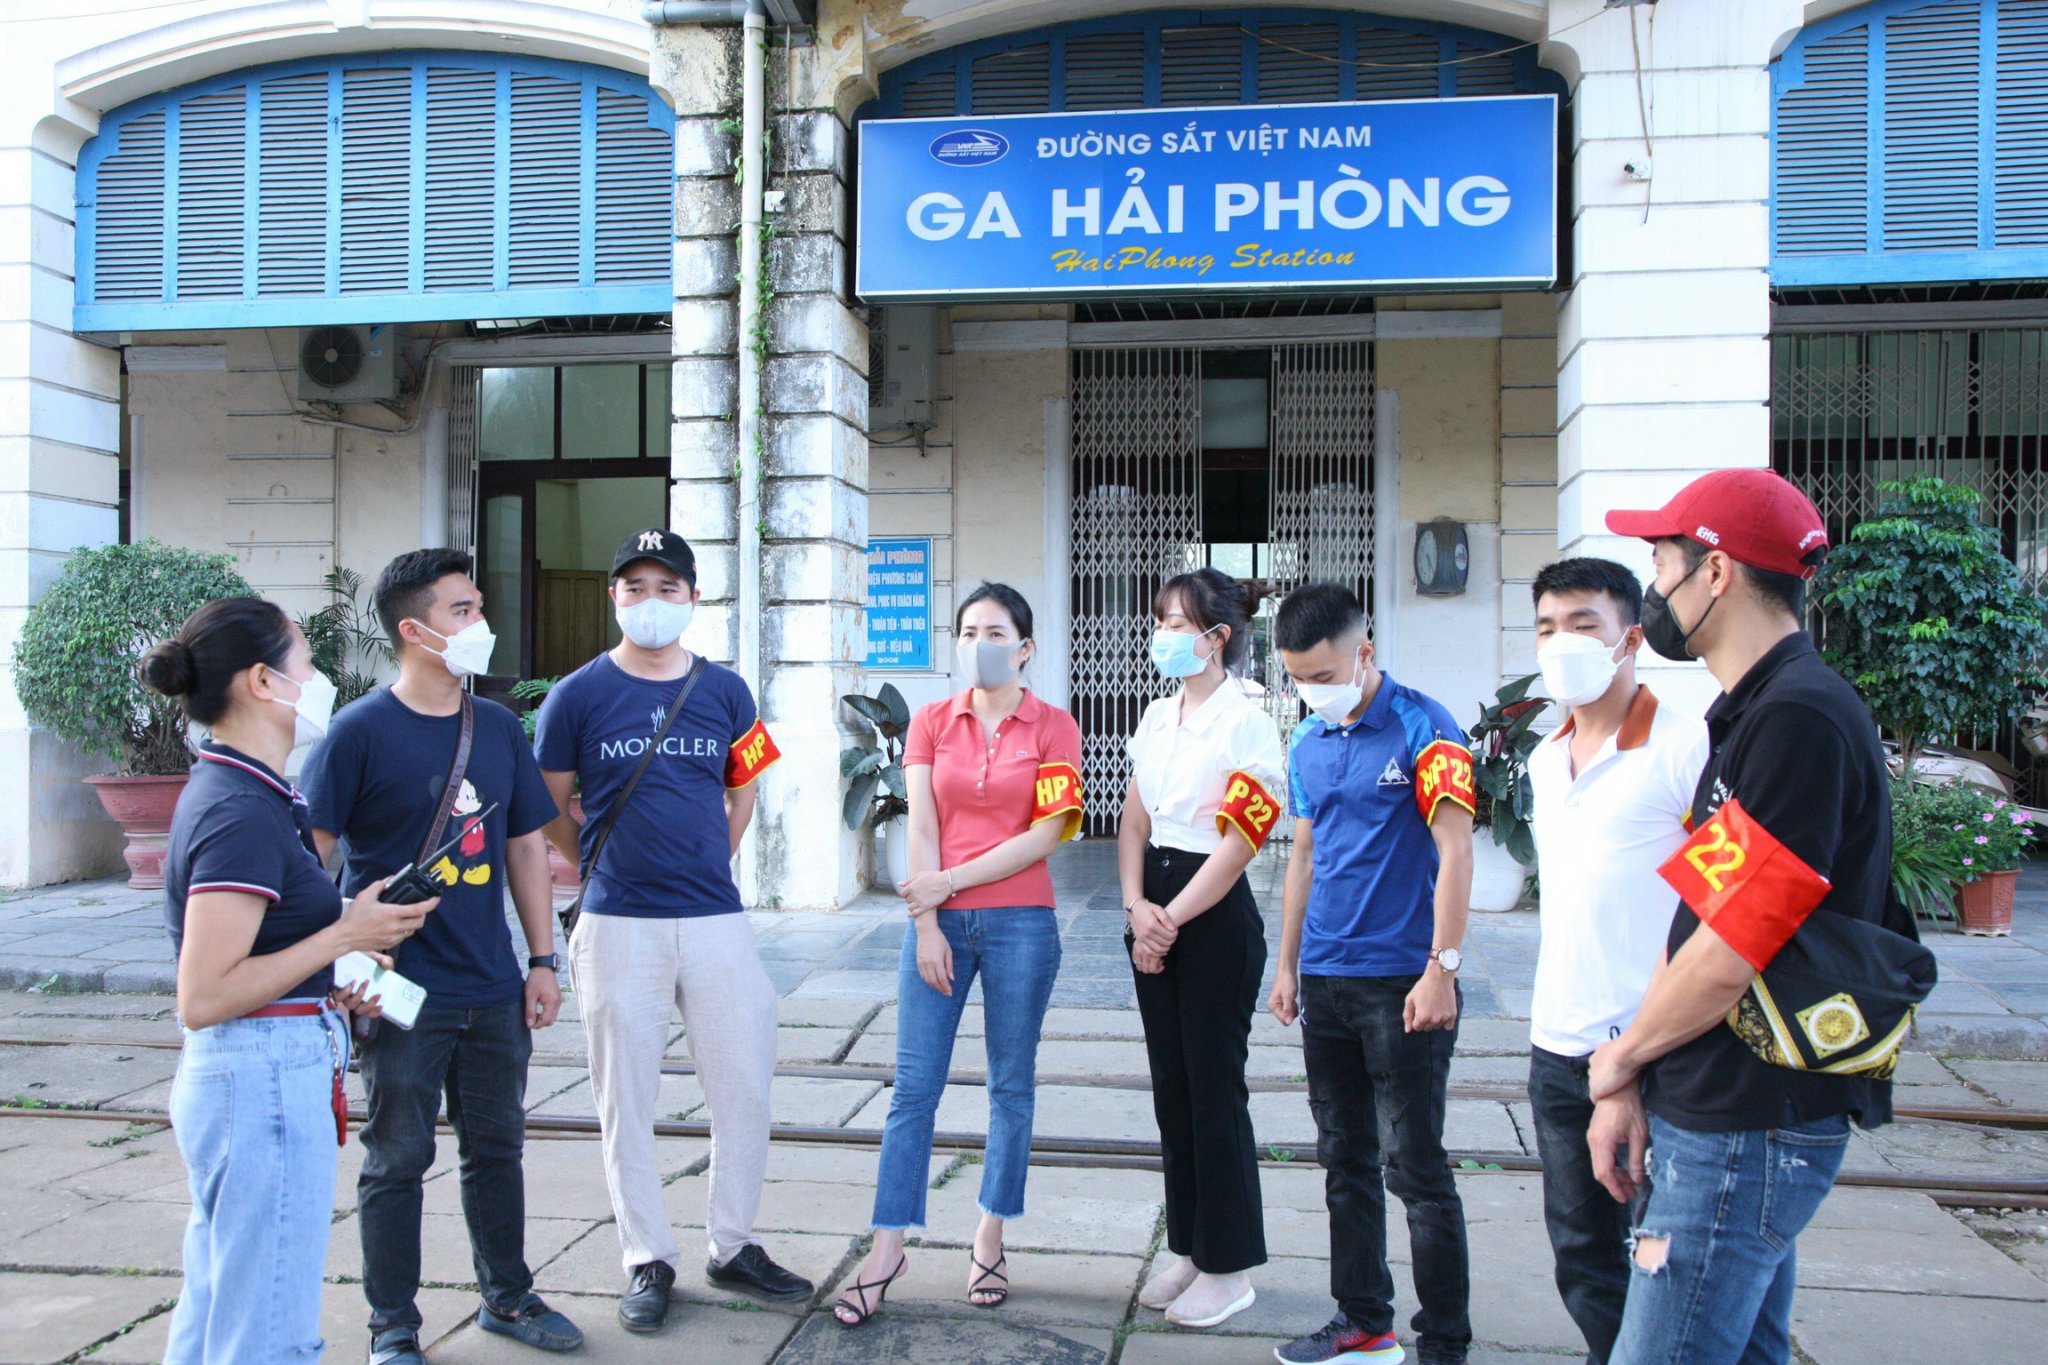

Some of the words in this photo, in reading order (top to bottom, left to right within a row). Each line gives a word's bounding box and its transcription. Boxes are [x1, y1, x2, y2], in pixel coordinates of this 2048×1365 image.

[1036, 130, 1151, 158] ĐƯỜNG
[1161, 121, 1216, 153] SẮT
[1226, 123, 1289, 156] VIỆT
[1299, 126, 1371, 148] NAM
[906, 190, 1021, 241] GA
[1050, 168, 1184, 237] HẢI
[1214, 164, 1511, 233] PHÒNG
[1230, 244, 1355, 268] Station
[600, 737, 719, 760] MONCLER
[740, 732, 767, 771] HP
[1036, 775, 1069, 807] HP
[1418, 753, 1448, 798] HP
[1449, 757, 1473, 795] 22
[1243, 793, 1273, 834] 22
[1683, 822, 1747, 894] 22
